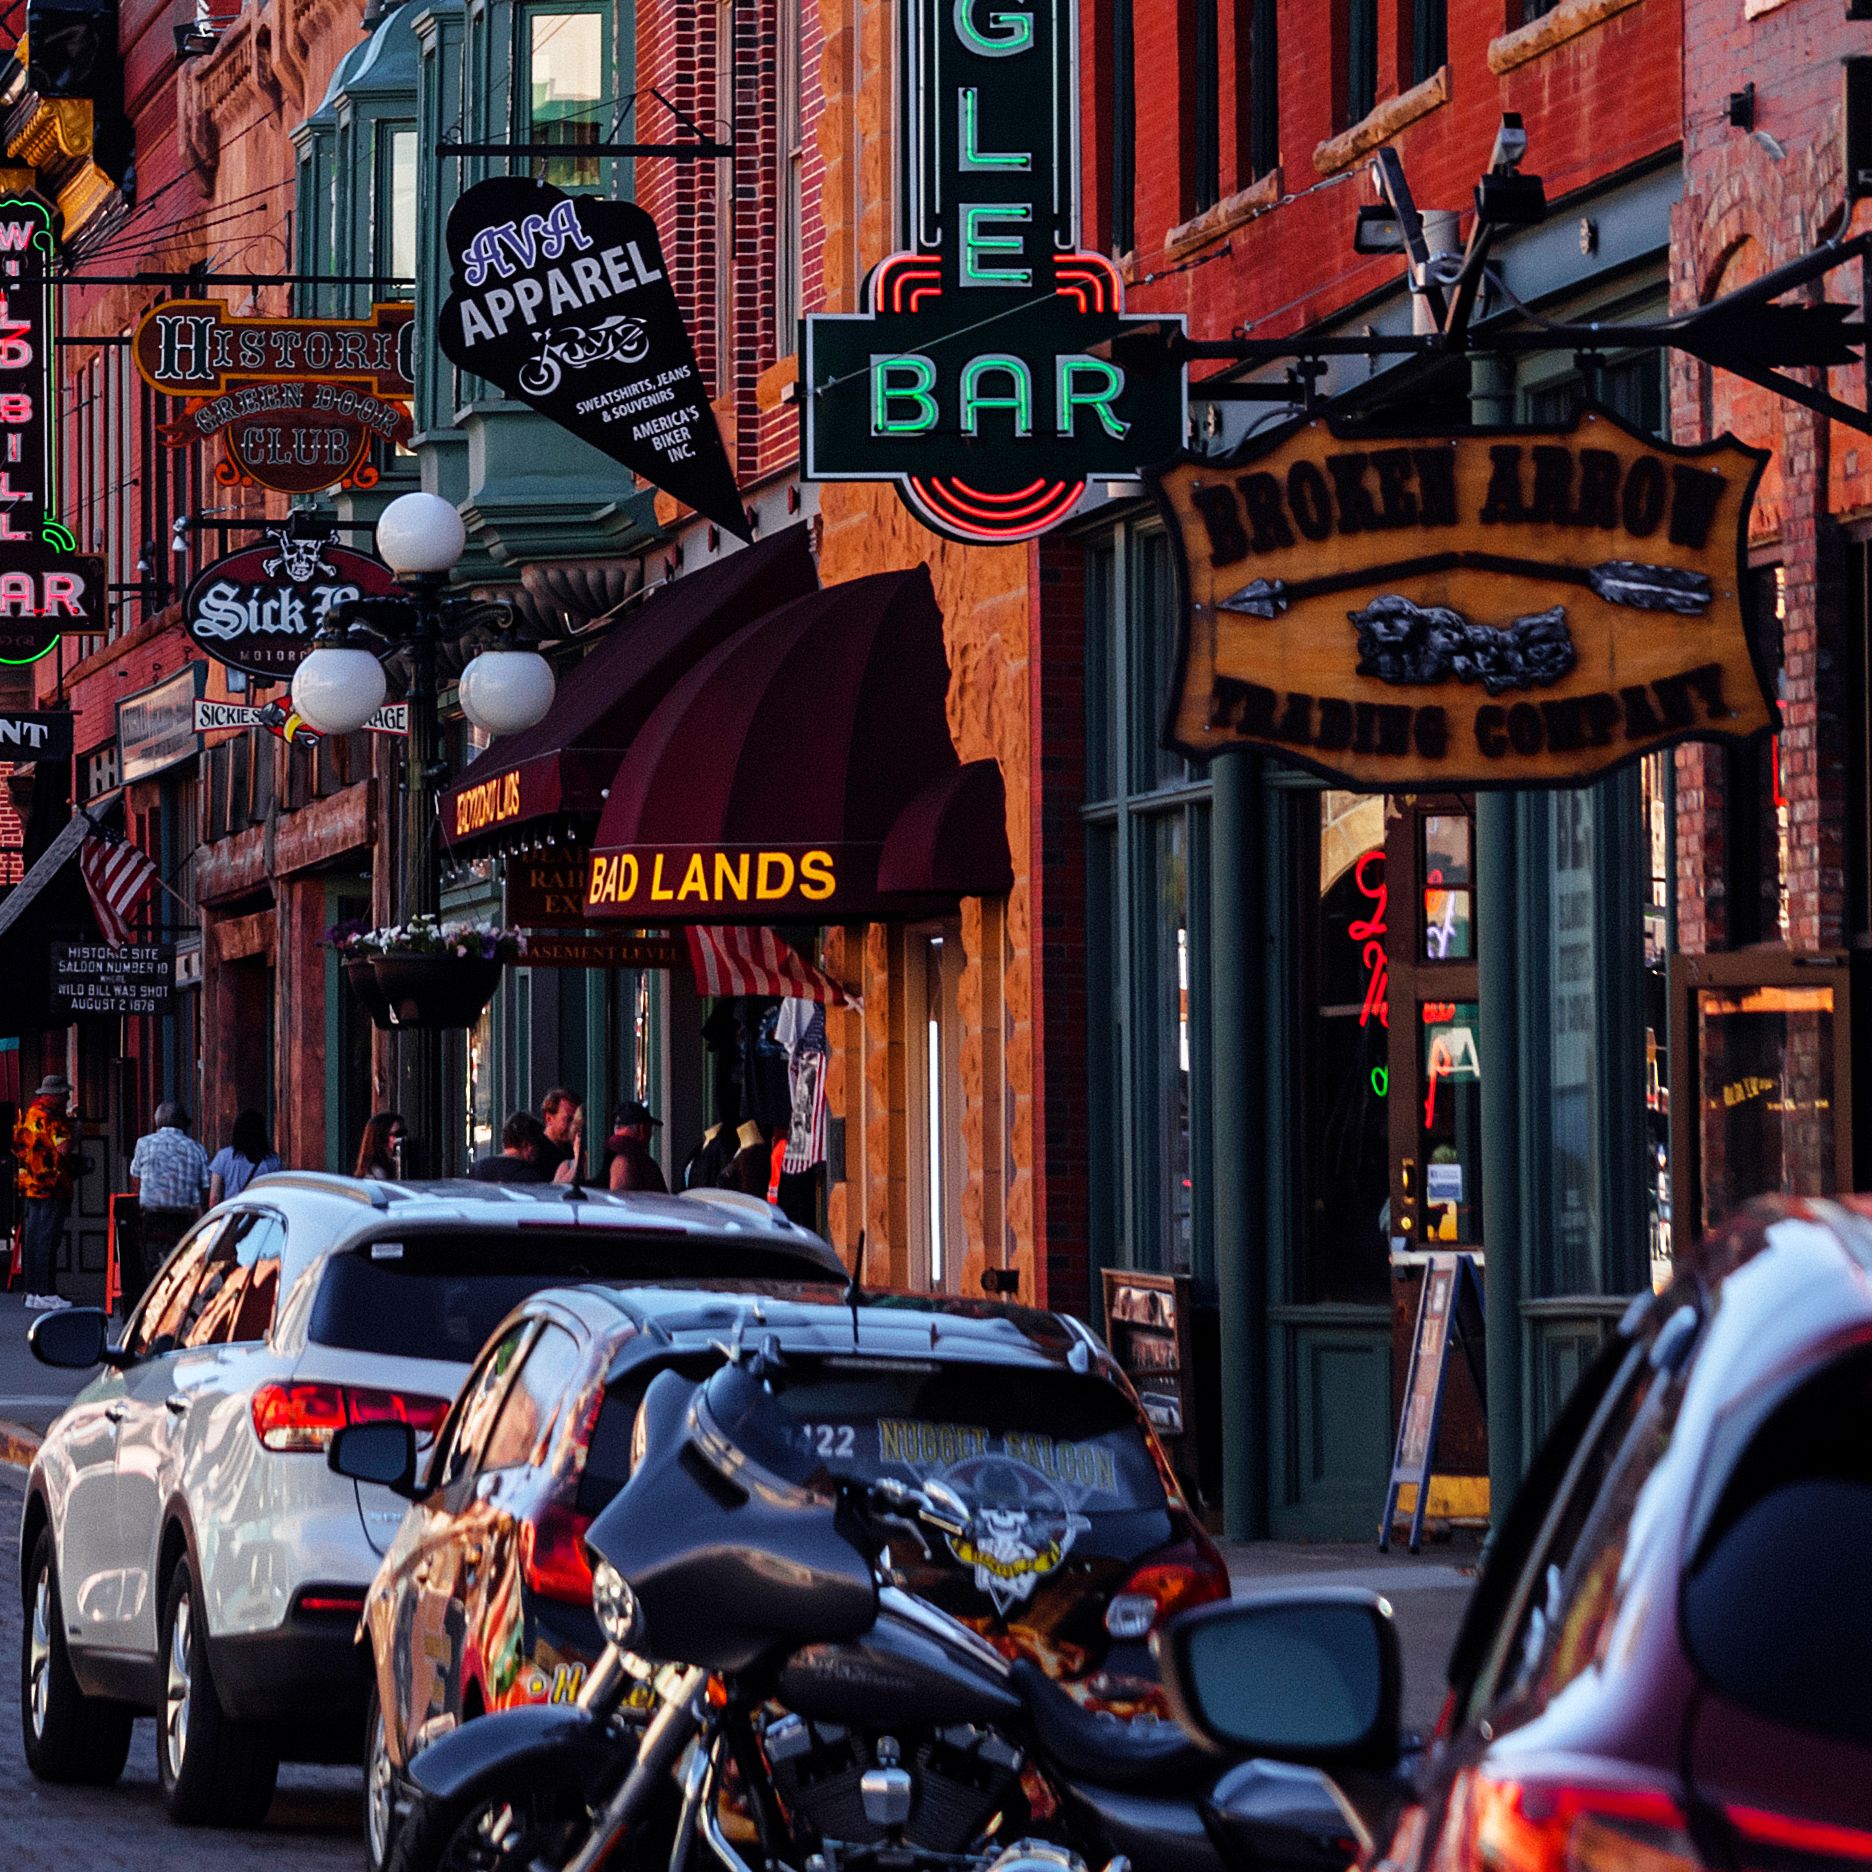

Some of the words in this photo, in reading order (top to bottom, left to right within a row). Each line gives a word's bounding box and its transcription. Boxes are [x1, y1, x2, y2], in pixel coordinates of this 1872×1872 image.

[462, 199, 593, 287] AVA
[460, 240, 662, 347] APPAREL
[576, 378, 655, 415] SWEATSHIRTS,
[656, 365, 692, 388] JEANS
[602, 407, 612, 422] &
[612, 388, 675, 419] SOUVENIRS
[870, 352, 1131, 438] BAR
[194, 383, 304, 434] GREEN
[313, 384, 400, 436] DOOR
[632, 405, 700, 441] AMERICA'S
[240, 428, 350, 465] CLUB
[652, 426, 692, 451] BIKER
[667, 444, 696, 463] INC.
[1193, 446, 1458, 568] BROKEN
[1480, 445, 1728, 548] ARROW
[193, 580, 308, 642] Sick
[240, 650, 308, 661] MOTORC
[199, 703, 261, 728] SICKIES
[366, 707, 406, 730] AGE
[1210, 675, 1448, 759] TRADING
[589, 856, 639, 905] BAD
[651, 850, 836, 903] LANDS
[59, 961, 103, 972] SALOON
[107, 962, 153, 974] NUMBER
[157, 963, 168, 974] 10
[68, 948, 128, 960] HISTORC
[131, 949, 159, 960] SITE
[59, 984, 85, 996] WILD
[88, 985, 111, 996] BILL
[113, 985, 137, 997] WAS
[140, 986, 169, 998] SHOT
[71, 998, 116, 1010] AUGUST
[119, 999, 127, 1011] 2
[877, 1418, 989, 1464] NUGGET
[1003, 1430, 1119, 1497] SALOON
